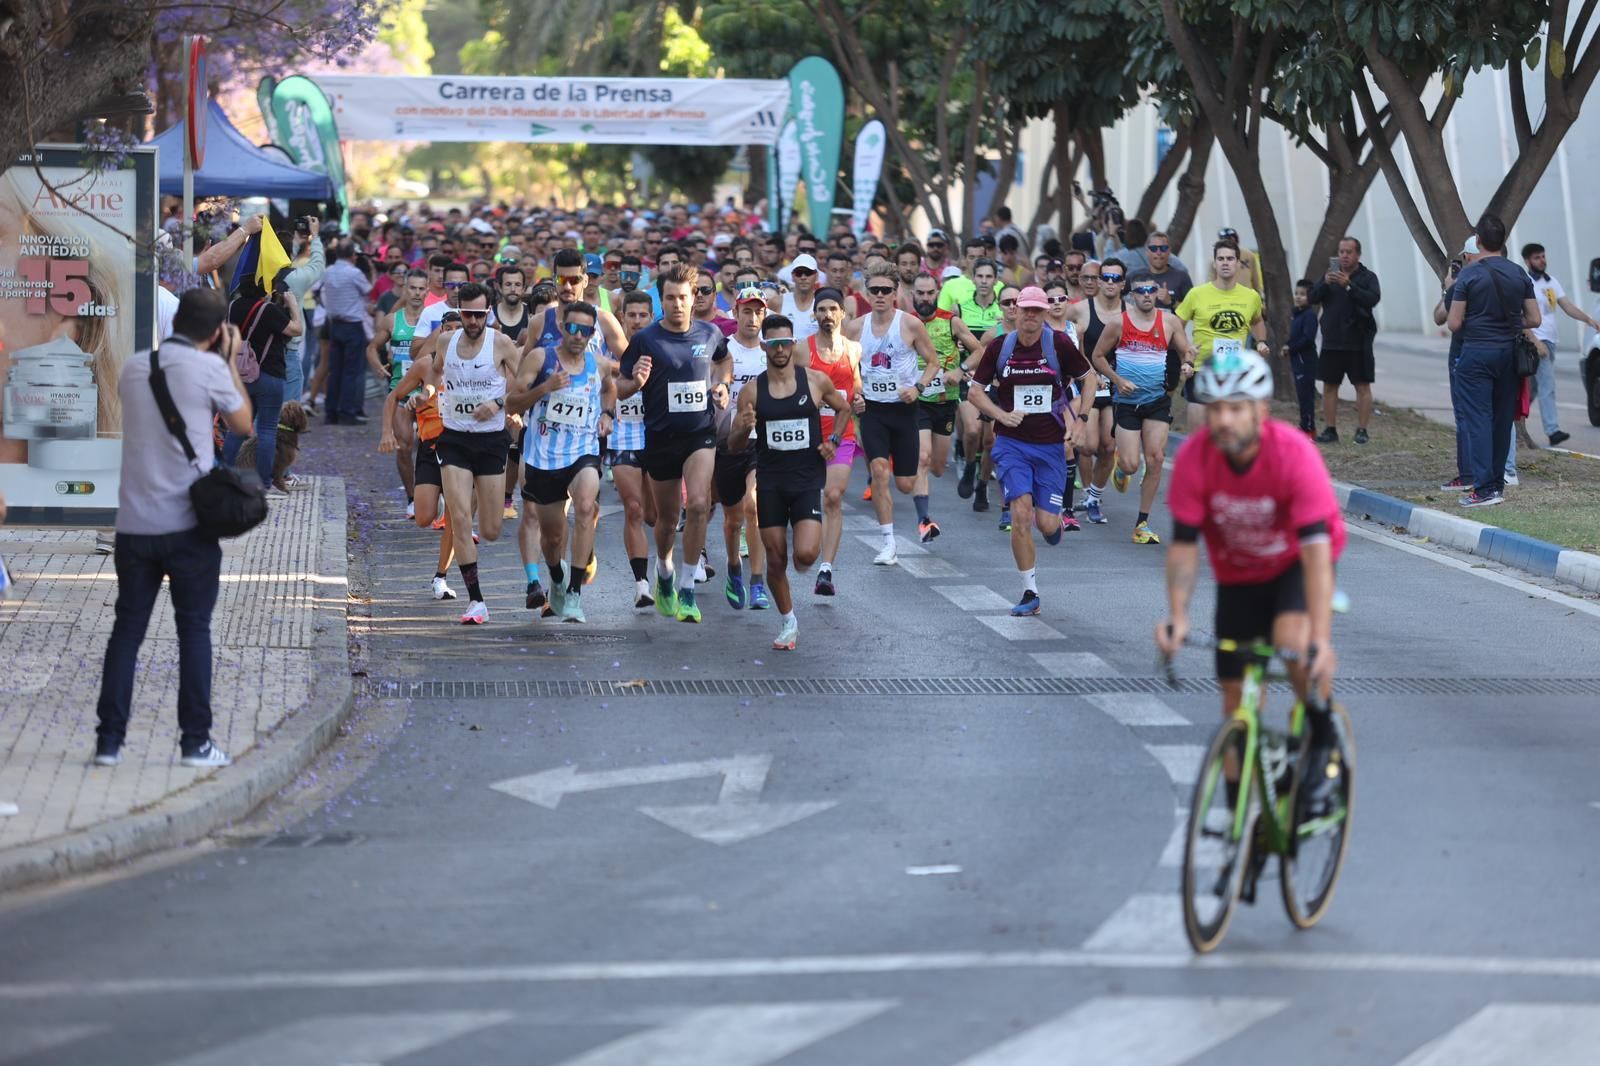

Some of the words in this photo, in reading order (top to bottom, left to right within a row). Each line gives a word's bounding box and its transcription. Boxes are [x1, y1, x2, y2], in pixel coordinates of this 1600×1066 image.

[438, 82, 525, 100] Carrera
[532, 82, 562, 102] de
[568, 83, 588, 103] la
[595, 85, 673, 103] Prensa
[32, 179, 124, 212] Avène
[19, 244, 90, 257] ANTIEDAD
[19, 259, 91, 317] 15
[34, 289, 47, 298] de
[871, 382, 897, 392] 693
[673, 391, 704, 404] 199
[1023, 394, 1044, 406] 28
[454, 402, 483, 415] 40
[552, 402, 584, 418] 471
[772, 430, 805, 442] 668
